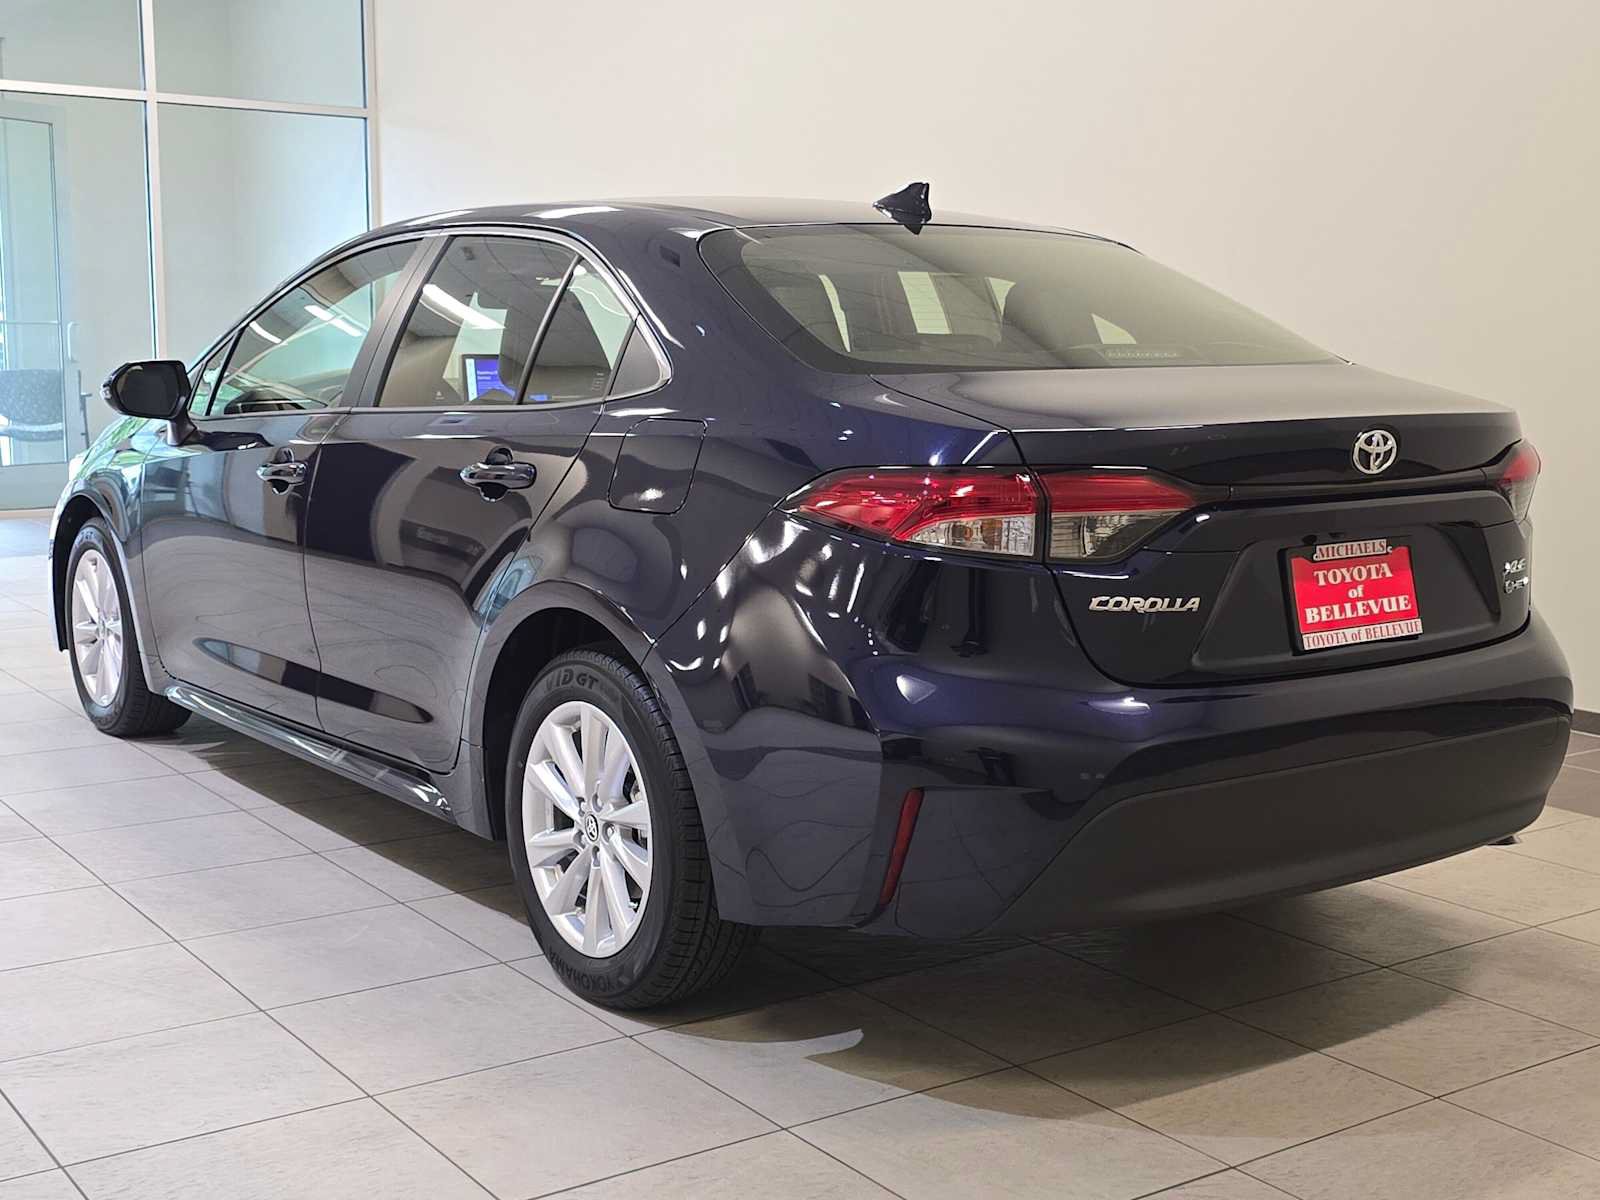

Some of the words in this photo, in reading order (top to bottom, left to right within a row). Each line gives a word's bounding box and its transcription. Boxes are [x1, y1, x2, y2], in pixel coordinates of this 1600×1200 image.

[1317, 540, 1386, 559] MICHAELS
[1314, 563, 1393, 586] TOYOTA
[1348, 585, 1364, 598] of
[1089, 596, 1201, 613] COROLLA
[1305, 595, 1411, 624] BELLEVUE
[1305, 632, 1349, 648] TOYOTA
[1351, 630, 1363, 641] of
[1365, 620, 1420, 639] BELLEVUE
[577, 673, 599, 689] GT
